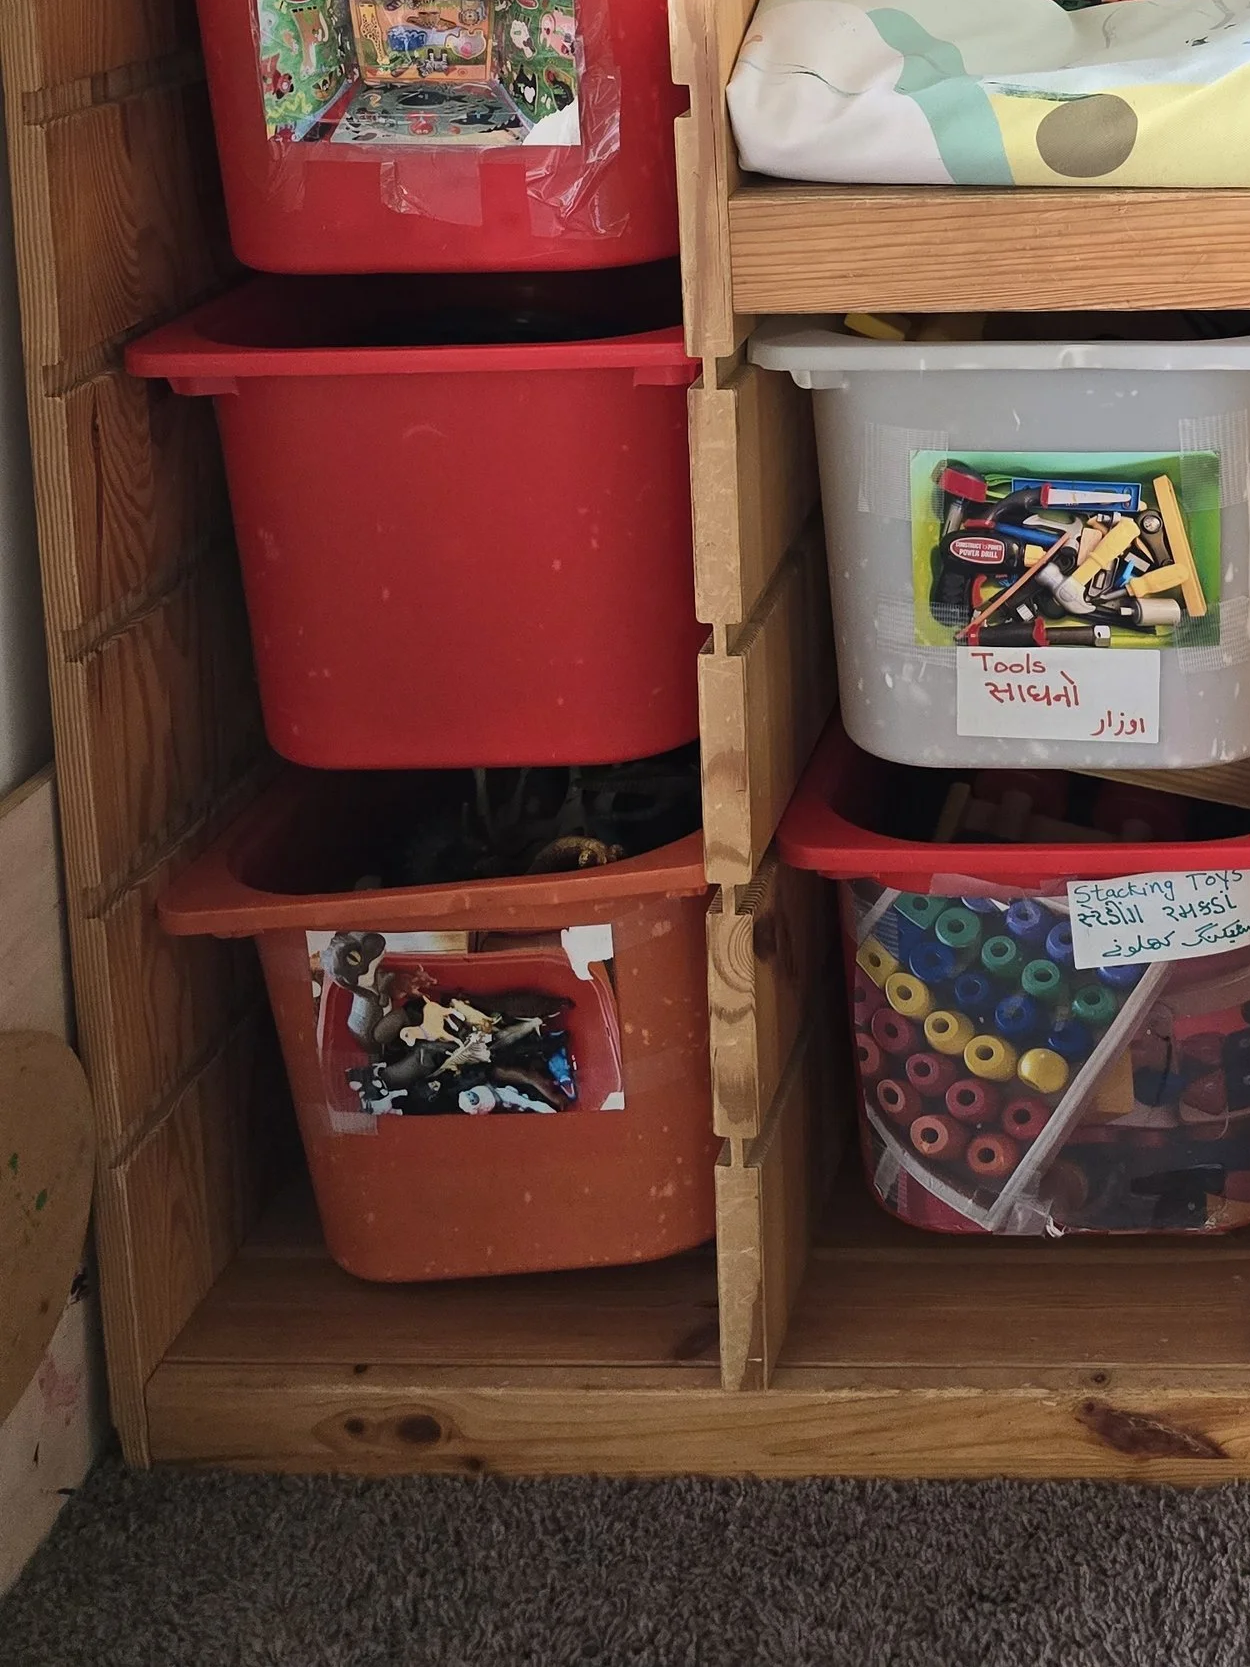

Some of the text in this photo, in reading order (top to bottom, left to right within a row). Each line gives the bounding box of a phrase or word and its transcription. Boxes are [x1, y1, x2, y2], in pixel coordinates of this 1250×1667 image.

[970, 651, 1047, 675] Tools
[1089, 710, 1146, 736] اوزار
[1073, 879, 1176, 904] Stacking
